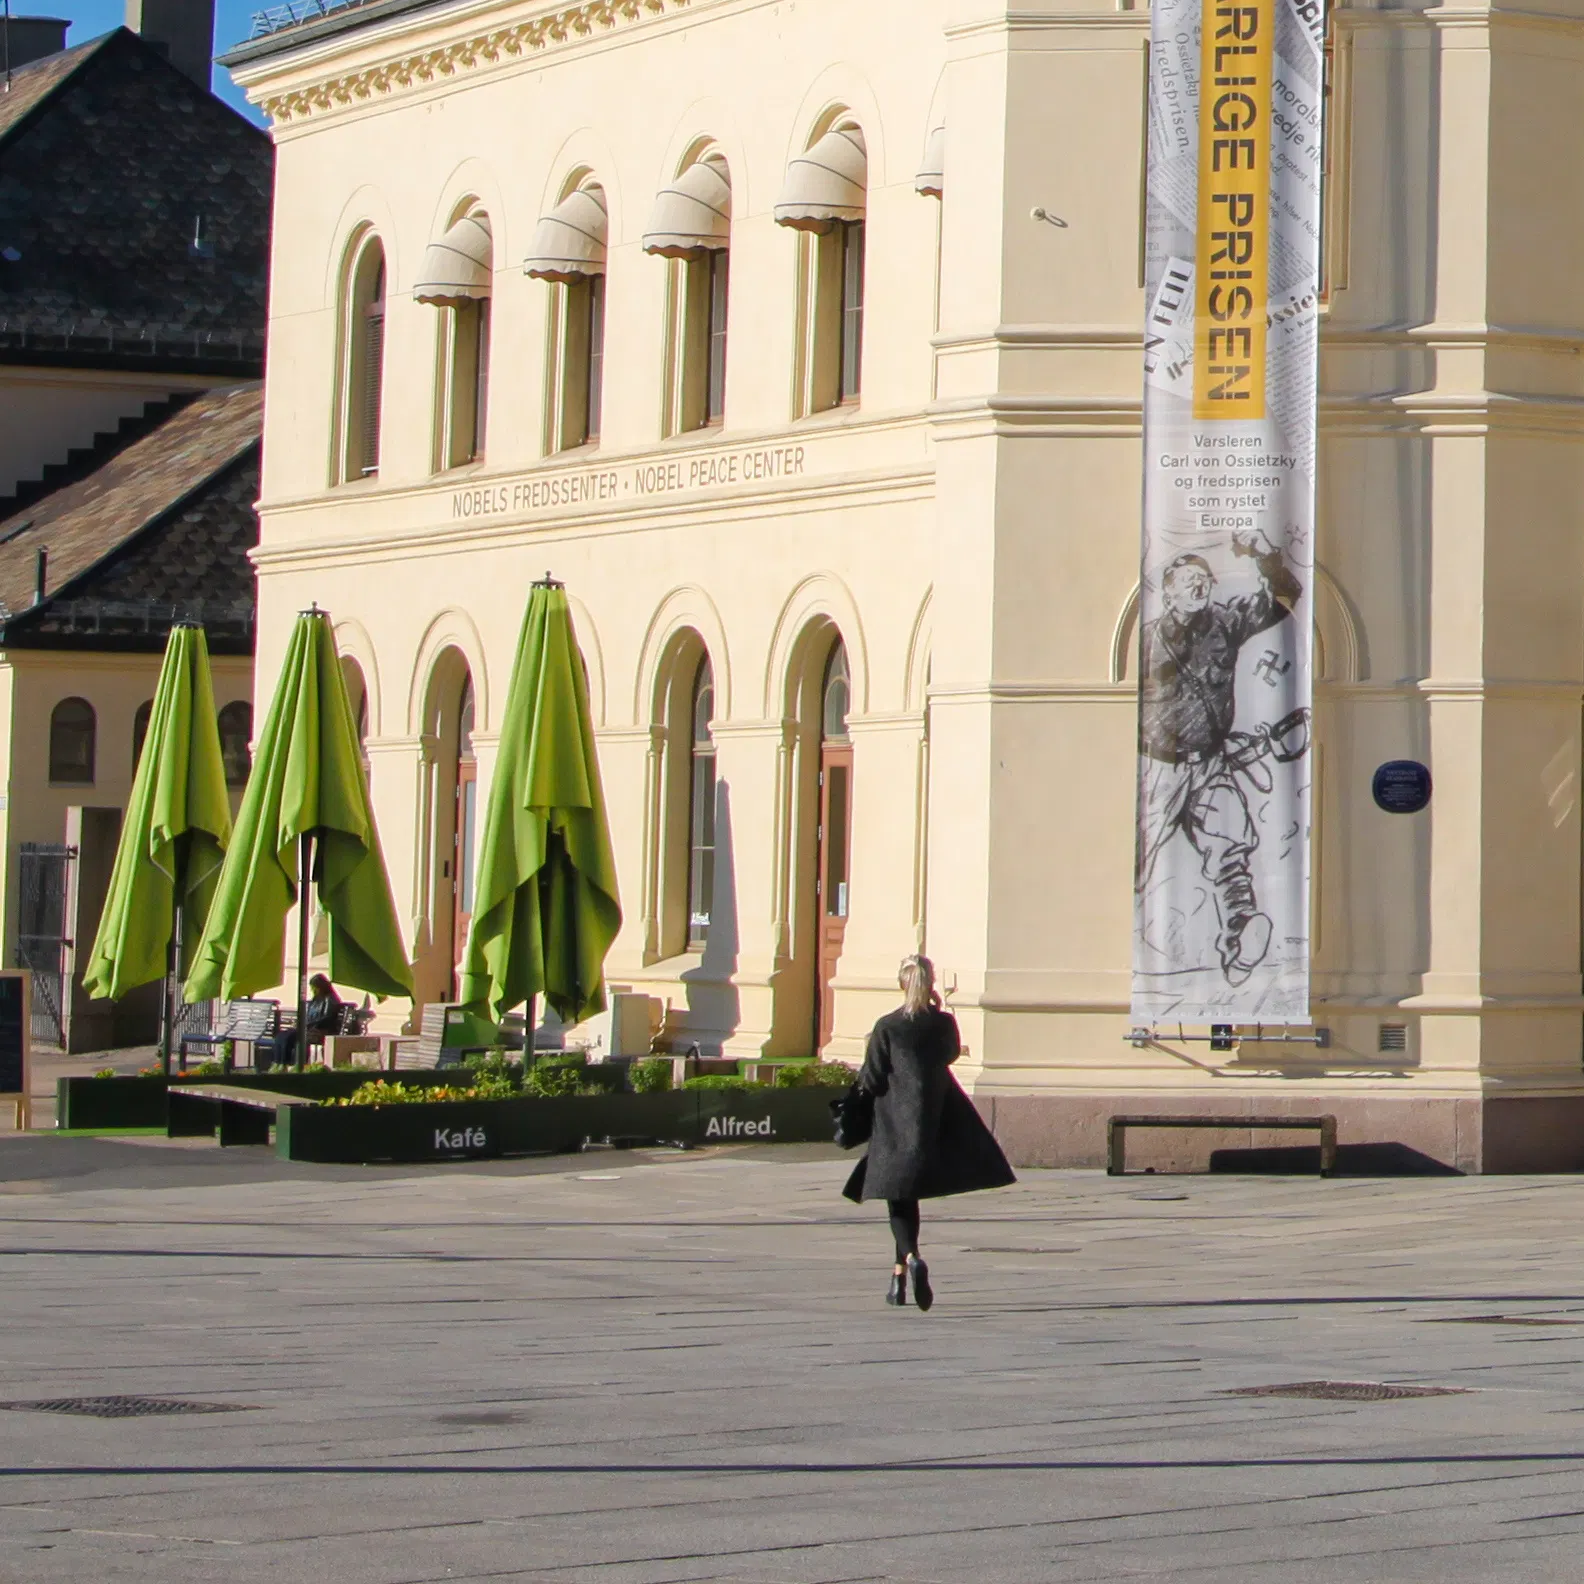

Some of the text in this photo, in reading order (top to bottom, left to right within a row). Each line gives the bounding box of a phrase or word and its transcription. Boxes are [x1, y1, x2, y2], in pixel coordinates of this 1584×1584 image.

[1174, 32, 1200, 97] Ossietzky
[1153, 39, 1191, 154] fredsprisen.
[1271, 102, 1305, 145] redje
[1153, 270, 1193, 326] FEIL
[1207, 193, 1255, 401] PRISEN
[1194, 435, 1262, 448] Varsleren
[1160, 454, 1297, 470] Carl von Ossietzky
[452, 446, 805, 518] NOBELS FREDSSENTER NOBEL PEACE CENTER
[1174, 474, 1281, 489] og fredsprisen
[1189, 494, 1266, 509] som rystet
[1201, 514, 1253, 529] Europa
[433, 1125, 487, 1149] Kafé
[705, 1115, 778, 1137] Alfred.
